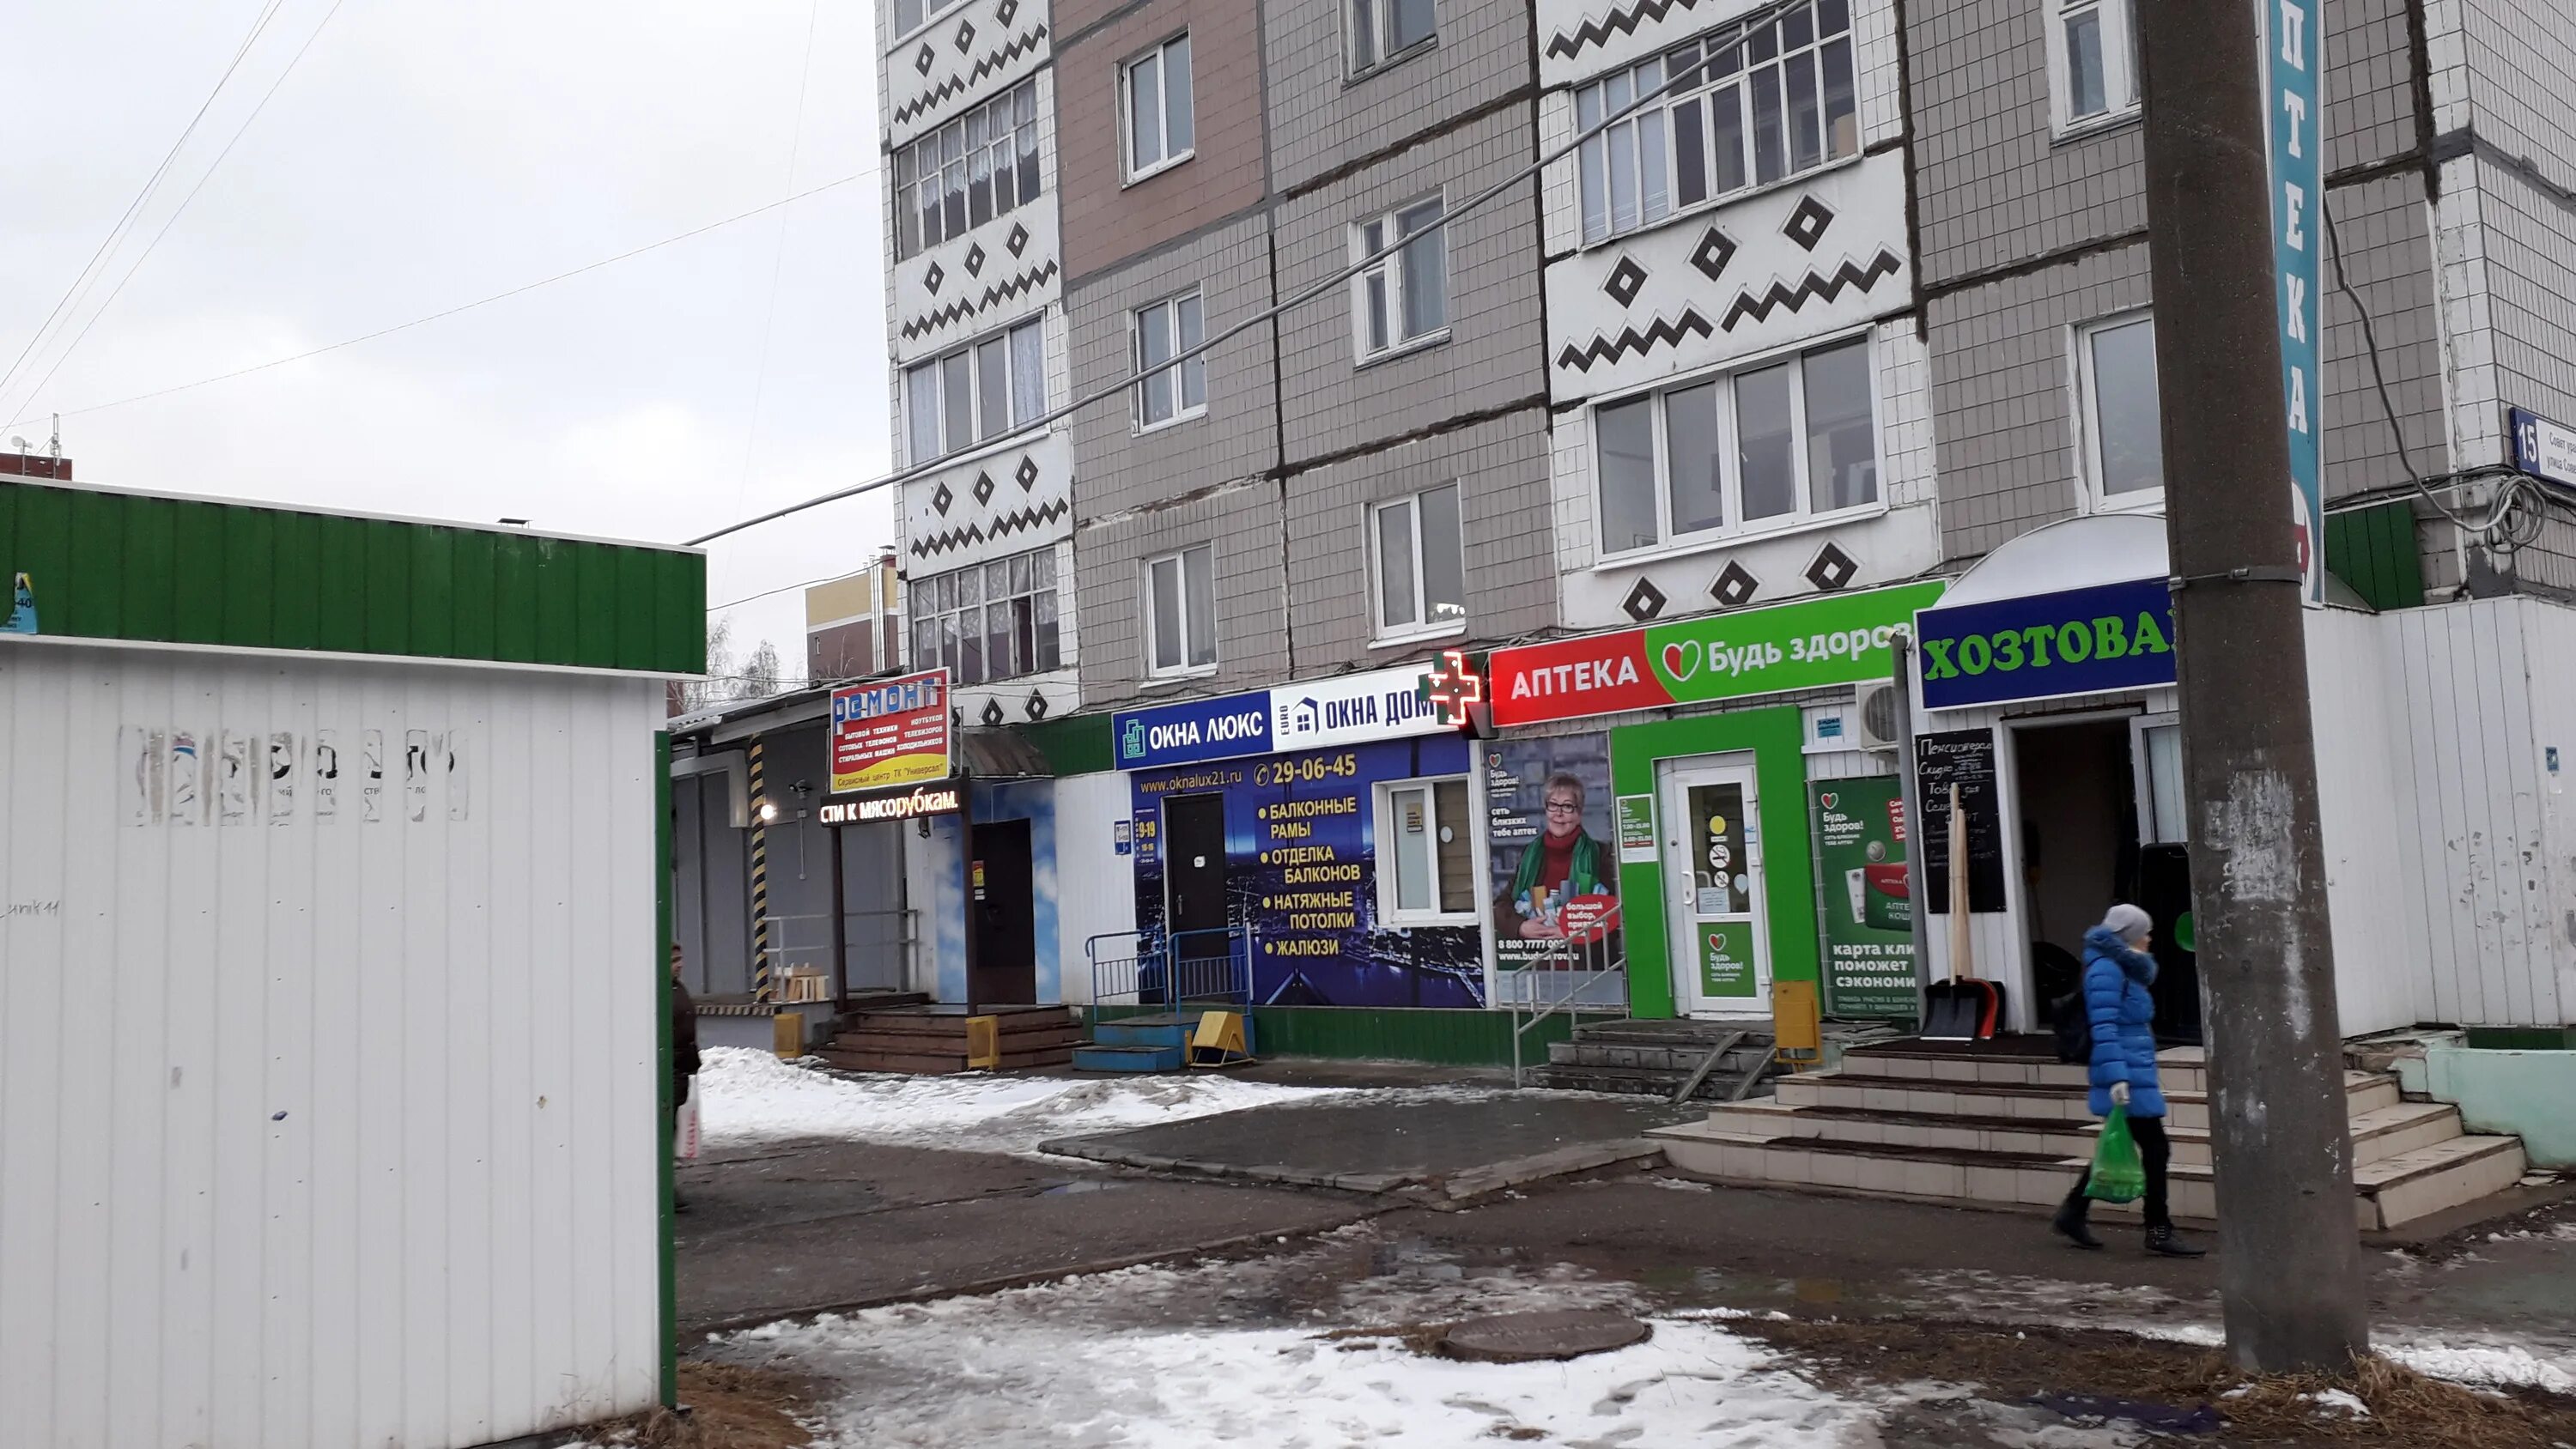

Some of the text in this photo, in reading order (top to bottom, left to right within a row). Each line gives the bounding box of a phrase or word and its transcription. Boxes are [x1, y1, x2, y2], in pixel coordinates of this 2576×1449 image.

[2280, 0, 2308, 434] ПТЕКА
[2519, 422, 2537, 462] 15
[1923, 609, 2177, 680] ХОЗТОВА
[1708, 640, 1783, 678] Будь
[1511, 655, 1639, 700] АПТЕКА
[911, 714, 943, 726] НОУТБУКОВ
[1325, 694, 1377, 730] ОКНА
[1279, 705, 1289, 736] EURO
[845, 724, 898, 740] БЫТОВОЙ ТЕХНИКИ
[904, 725, 943, 738] ТЕЛЕВИЗОРОВ
[1149, 711, 1263, 750] ОКНА ЛЮКС
[838, 736, 897, 752] СОТОВЫХ ТЕЛЕФОНОВ
[896, 737, 943, 752] ХОЛОДИЛЬНИКОВ
[838, 748, 896, 764] СТИРАЛЬНЫХ МАШИН
[1273, 753, 1357, 784] 29-06-45
[1490, 769, 1508, 778] Будь
[838, 773, 870, 787] Сервисный
[872, 773, 890, 782] центр
[894, 768, 902, 779] ТК
[1140, 770, 1242, 793] www.oknalux21.ru
[1491, 776, 1519, 787] здоров!
[1270, 797, 1357, 820] БАЛКОННЫЕ
[1492, 817, 1527, 827] близких
[1823, 812, 1847, 823] Будь
[1270, 822, 1311, 840] РАМЫ
[1493, 828, 1537, 837] тебе аптек
[1824, 821, 1863, 833] здоров!
[1272, 846, 1335, 866] ОТДЕЛКА
[1284, 864, 1361, 884] БАЛКОНОВ
[1273, 891, 1353, 910] НАТЯЖНЫЕ
[1565, 902, 1603, 911] большой
[1290, 912, 1355, 930] ПОТОЛКИ
[1276, 939, 1339, 956] ЖАЛЮЗИ
[1498, 940, 1504, 949] 8
[1506, 940, 1523, 949] 800
[1524, 940, 1546, 949] 7777
[1833, 944, 1916, 959] карта кли
[1710, 953, 1730, 962] Будь
[1710, 961, 1744, 971] здоров!
[1835, 961, 1909, 971] поможет
[1836, 976, 1916, 988] сэкономи
